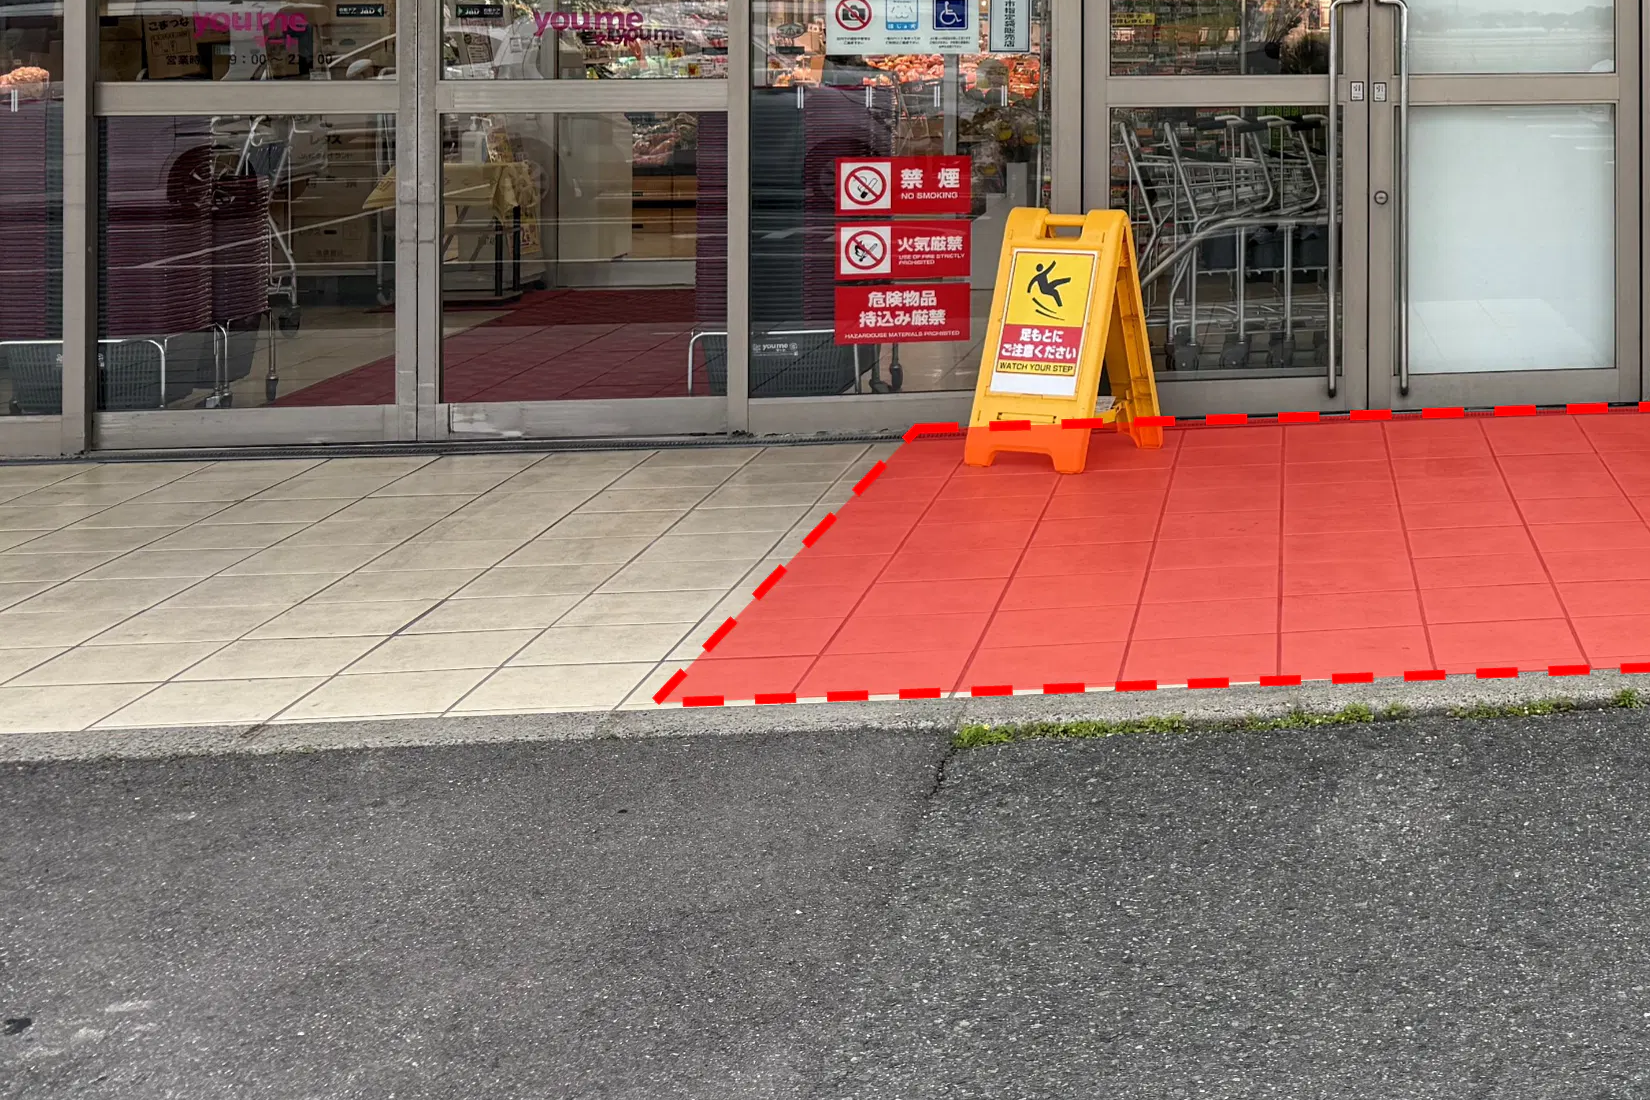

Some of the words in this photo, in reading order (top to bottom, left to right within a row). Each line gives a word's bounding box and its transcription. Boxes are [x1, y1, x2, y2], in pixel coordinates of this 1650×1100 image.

[148, 17, 190, 32] こまつな
[193, 10, 308, 39] youme
[532, 9, 644, 38] youme
[166, 54, 209, 66] 営業時
[900, 168, 960, 189] 禁煙
[901, 192, 914, 200] NO
[897, 236, 963, 252] 火気厳禁
[868, 290, 937, 308] 危険物品
[859, 309, 947, 328] 持込み厳禁
[1020, 327, 1064, 343] 足もとに
[1001, 343, 1077, 360] ご注意ください
[1000, 362, 1028, 370] WATCH
[1029, 364, 1052, 372] YOUR
[1052, 365, 1073, 373] STEP
